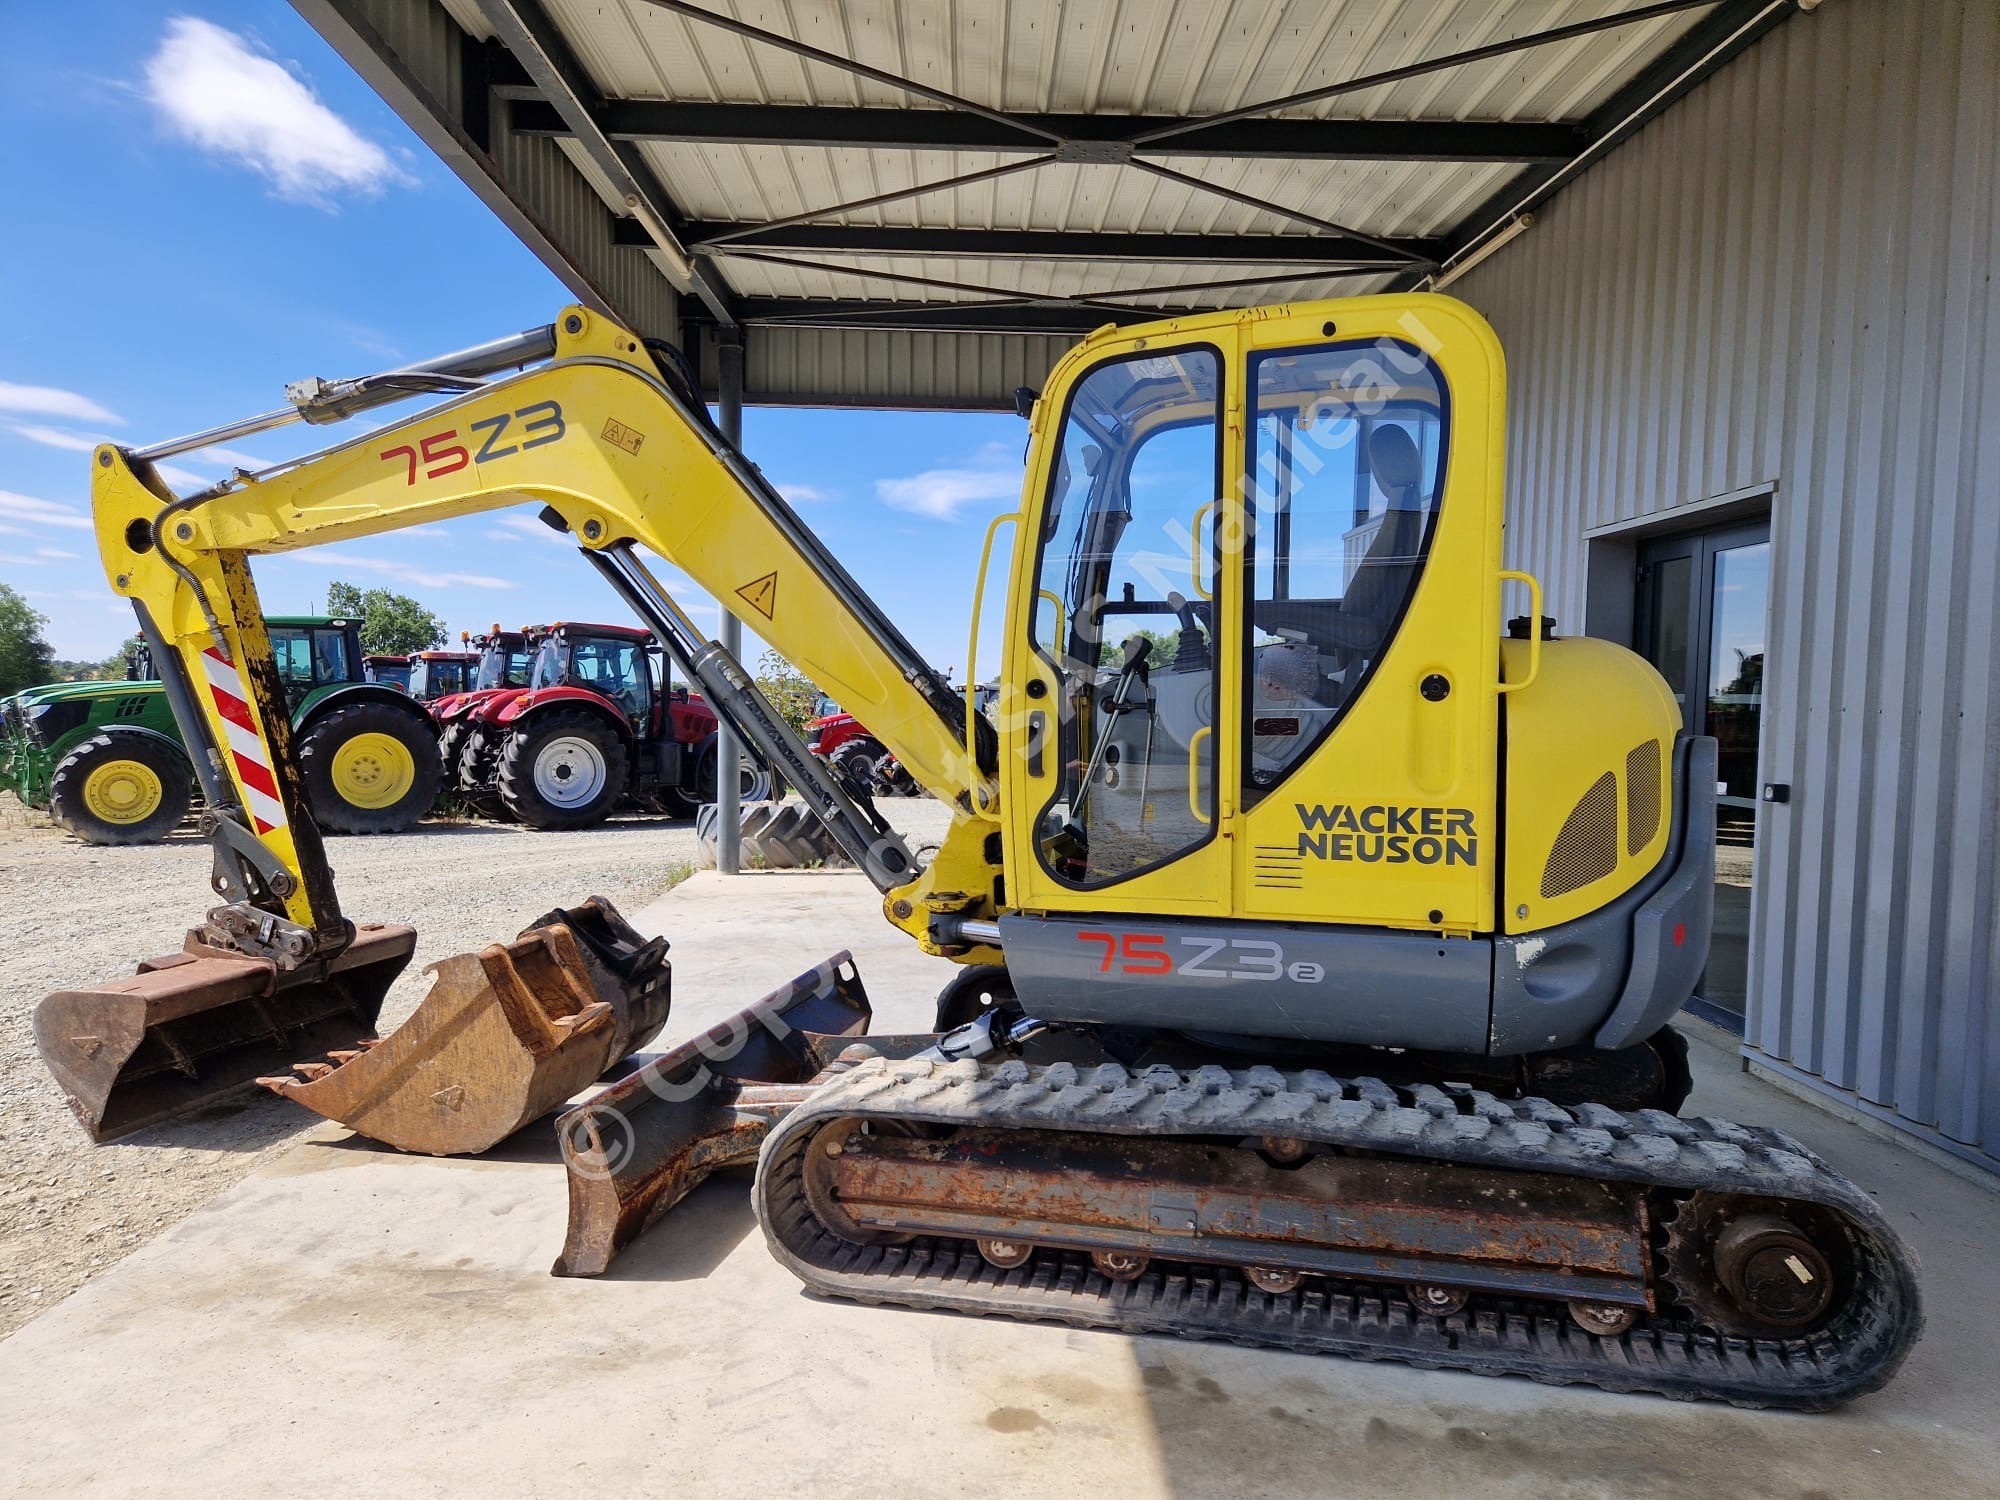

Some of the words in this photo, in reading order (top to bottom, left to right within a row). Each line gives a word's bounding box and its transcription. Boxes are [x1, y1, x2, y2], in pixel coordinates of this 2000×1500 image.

[380, 400, 566, 486] 75Z3
[1295, 803, 1477, 836] WACKER
[1298, 833, 1477, 866] NEUSON
